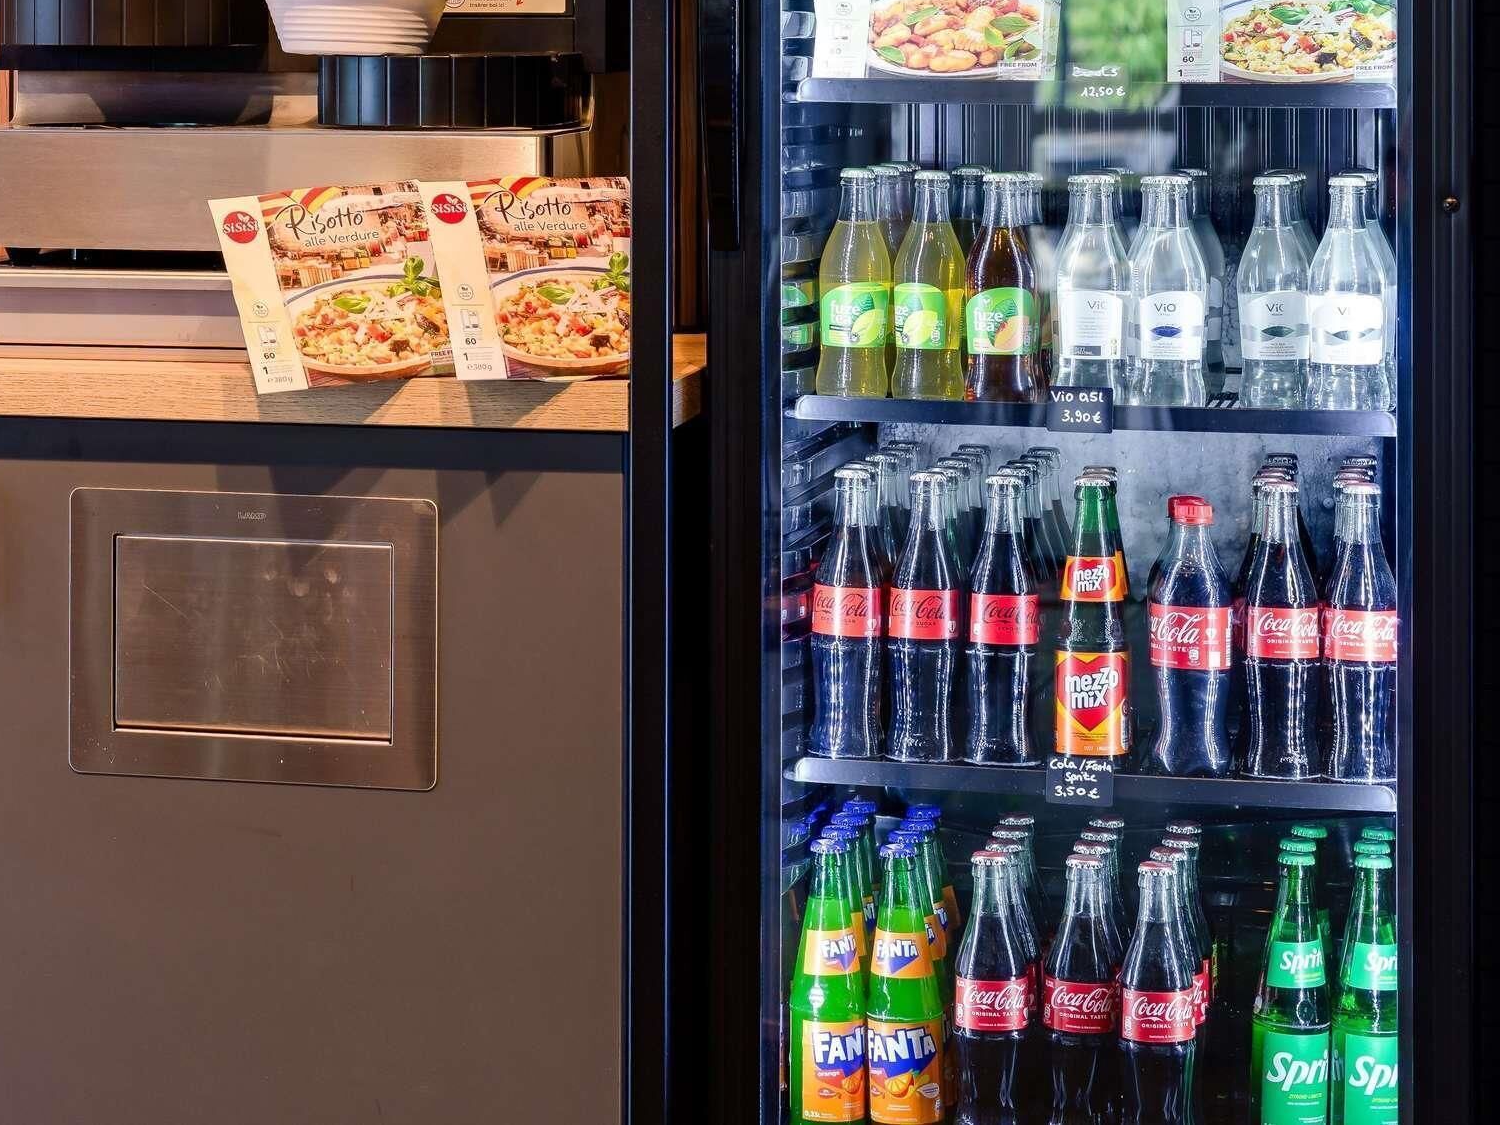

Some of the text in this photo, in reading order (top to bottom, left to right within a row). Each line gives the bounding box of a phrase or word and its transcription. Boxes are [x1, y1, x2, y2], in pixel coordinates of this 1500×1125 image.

[1182, 55, 1194, 63] 60
[486, 190, 572, 223] Risotto
[276, 203, 367, 241] Risotto
[514, 220, 587, 232] alle Verdure
[304, 229, 380, 248] alle Verdure
[830, 299, 860, 315] fuze
[974, 307, 1003, 322] fuze
[974, 320, 995, 332] tea
[263, 352, 276, 360] 60
[1050, 390, 1074, 403] Vio
[1072, 565, 1110, 582] mezzo
[1077, 579, 1102, 593] mix
[983, 600, 1037, 624] Coca-Col
[1064, 666, 1119, 692] mezzo
[1071, 684, 1109, 709] mix
[1049, 758, 1078, 770] Cola
[820, 933, 856, 958] FANT
[876, 939, 918, 957] FANTA
[1280, 948, 1323, 974] Sprit
[963, 984, 1026, 1011] Coca-Cola
[1051, 985, 1114, 1013] Coca-Cola
[1059, 1012, 1089, 1020] ORIGINAL
[1131, 995, 1194, 1022] Coca-Cola
[813, 1026, 866, 1065] FAN
[1267, 1049, 1329, 1092] Spri
